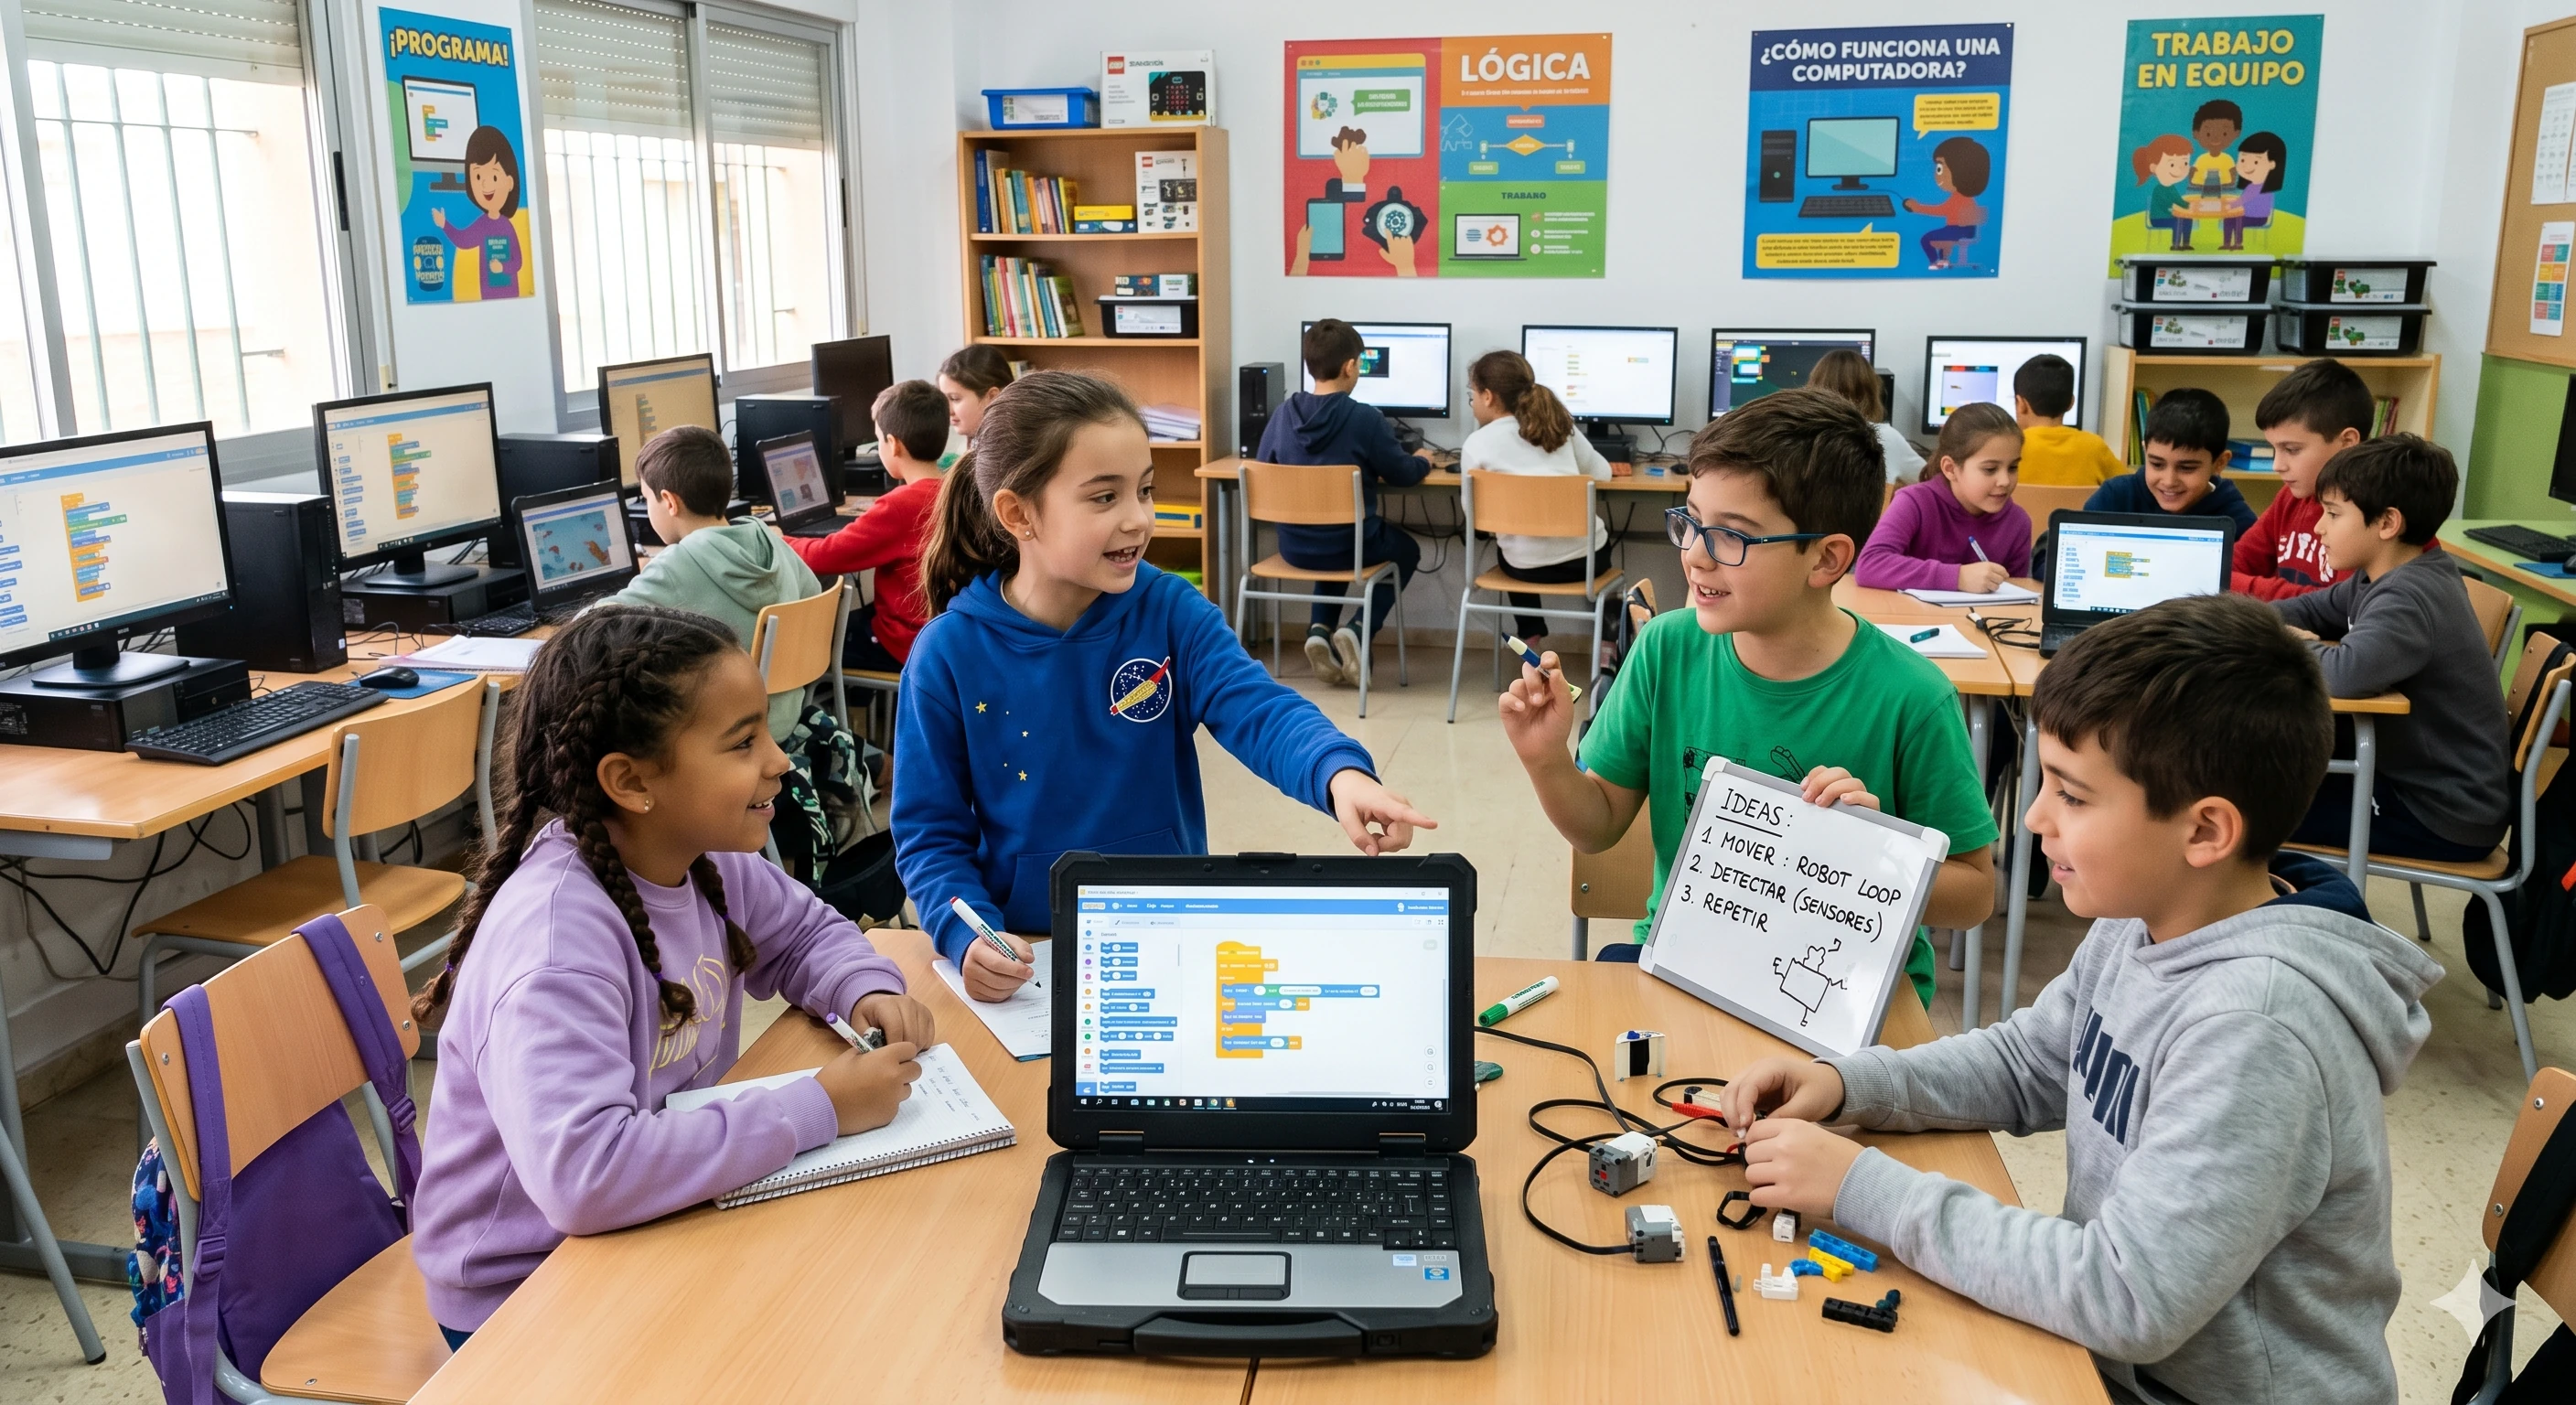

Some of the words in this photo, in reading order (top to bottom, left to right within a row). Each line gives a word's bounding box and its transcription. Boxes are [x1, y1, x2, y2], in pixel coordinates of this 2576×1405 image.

[391, 28, 508, 66] ¡PROGRAMA!
[1760, 39, 1837, 66] ¿CÓMO
[1841, 39, 1950, 59] FUNCIONA
[1955, 38, 2001, 56] UNA
[2152, 29, 2294, 57] TRABAJO
[1461, 48, 1591, 82] LÓGICA
[1791, 60, 1967, 82] COMPUTADORA?
[2137, 63, 2177, 89] EN
[2185, 60, 2305, 88] EQUIPO
[1701, 826, 1712, 846] 1.
[1721, 831, 1775, 865] MOVER
[1796, 855, 1853, 888] ROBOT
[1857, 879, 1902, 907] LOOP
[1680, 885, 1695, 906] 3.
[1704, 893, 1768, 932] REPETIR
[1689, 854, 1703, 875] 2.
[1710, 862, 1787, 905] DETECTAR
[1793, 887, 1884, 943] (SENSORES)
